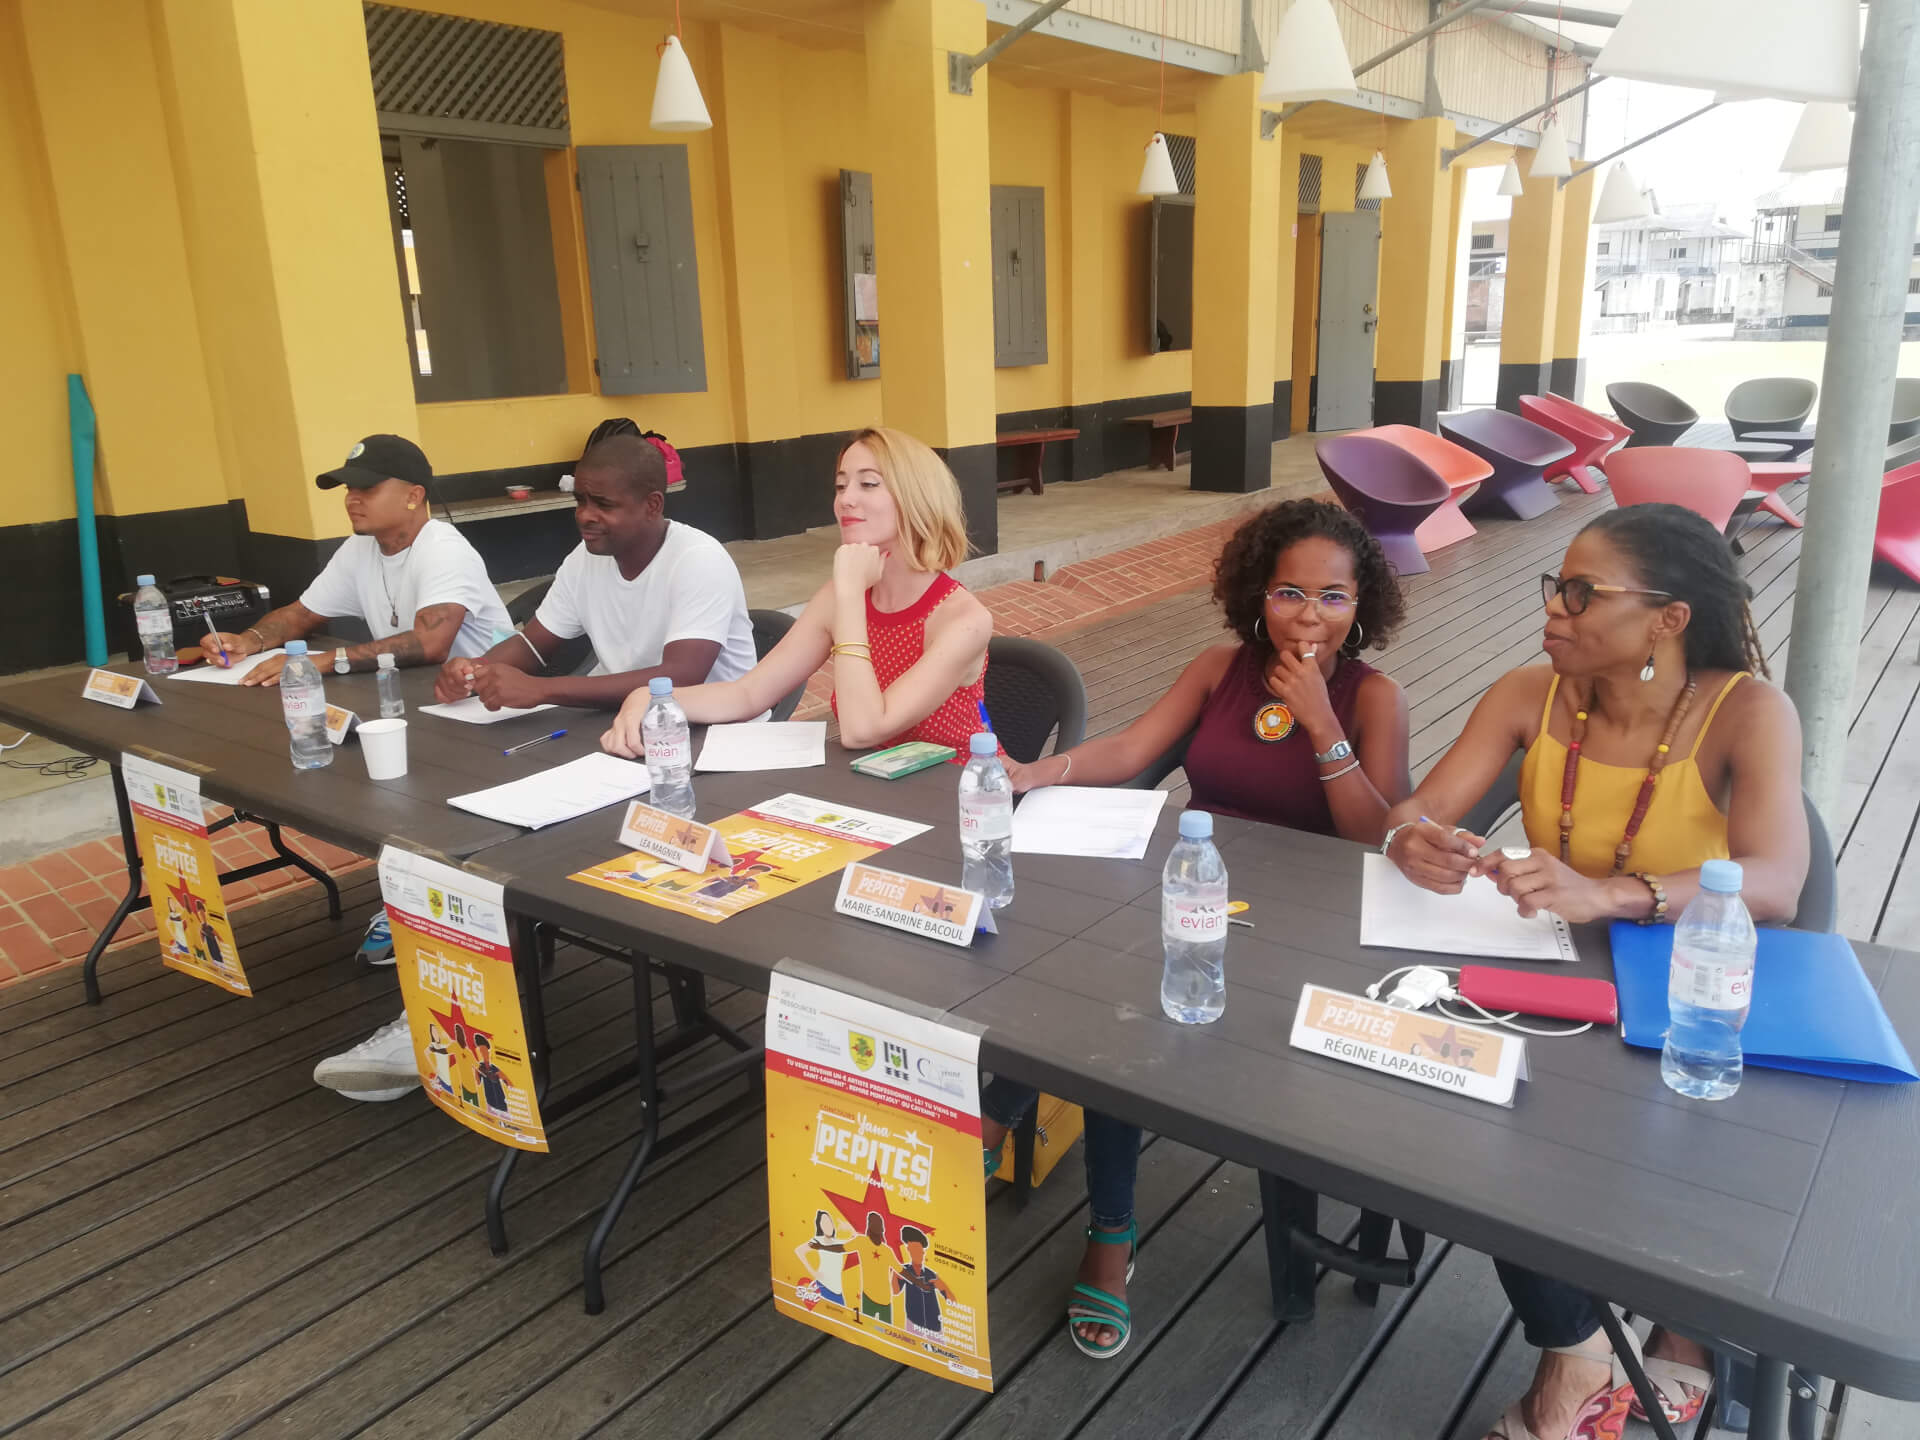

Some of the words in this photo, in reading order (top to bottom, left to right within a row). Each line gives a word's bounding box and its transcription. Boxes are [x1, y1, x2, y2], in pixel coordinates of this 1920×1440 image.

[648, 746, 679, 758] evian
[652, 842, 680, 861] MAGNIEN
[858, 876, 905, 900] PEPITES
[842, 898, 922, 929] MARIE-SANDRINE
[924, 920, 964, 940] BACOUL
[1180, 912, 1223, 930] evian
[419, 958, 482, 1005] PEPITES
[1320, 1005, 1393, 1038] PEPITES
[1324, 1037, 1377, 1063] RÉGINE
[1381, 1053, 1466, 1089] LAPASSION
[924, 1101, 933, 1109] TU
[933, 1104, 949, 1116] VIENS
[857, 1111, 888, 1137] Yana
[818, 1121, 930, 1187] PEPITES
